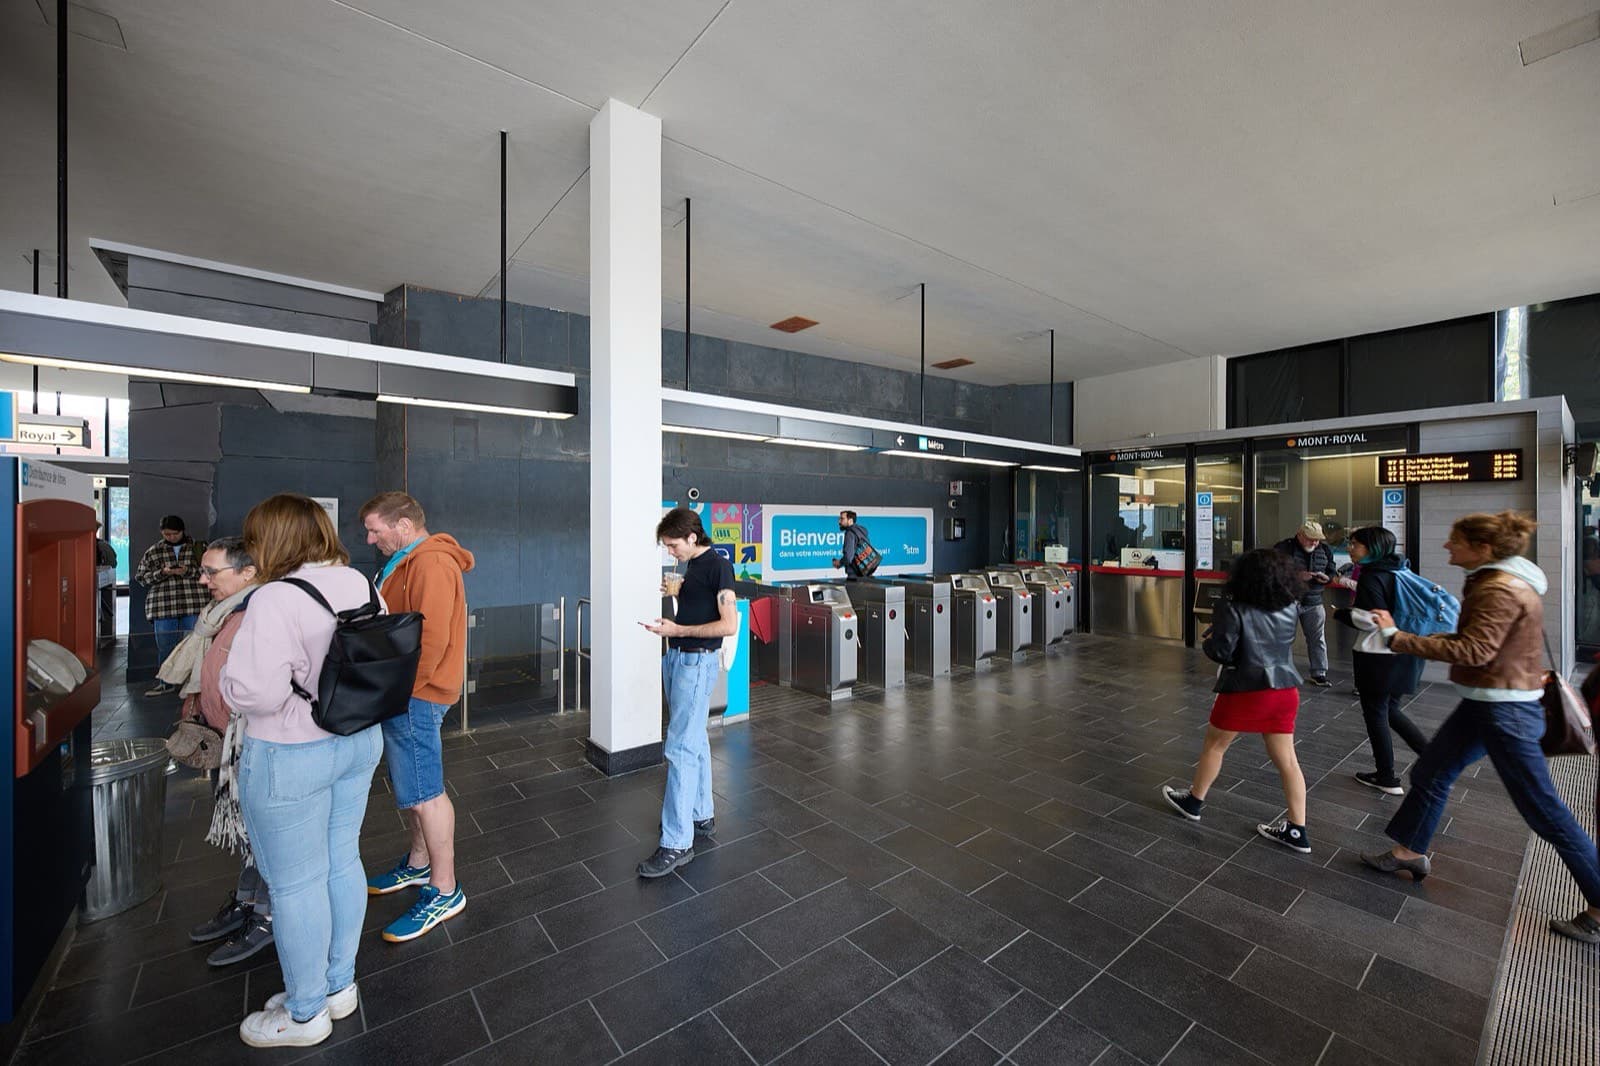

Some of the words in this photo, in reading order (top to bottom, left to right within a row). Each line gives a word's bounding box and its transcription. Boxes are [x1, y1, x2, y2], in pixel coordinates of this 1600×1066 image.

[1297, 433, 1368, 447] MONT-ROYAL
[1117, 450, 1164, 461] MONT-ROYAL
[1431, 461, 1468, 469] Mont-Royal
[780, 529, 844, 546] Bienven
[812, 549, 837, 557] nouvelle
[905, 545, 919, 554] stm
